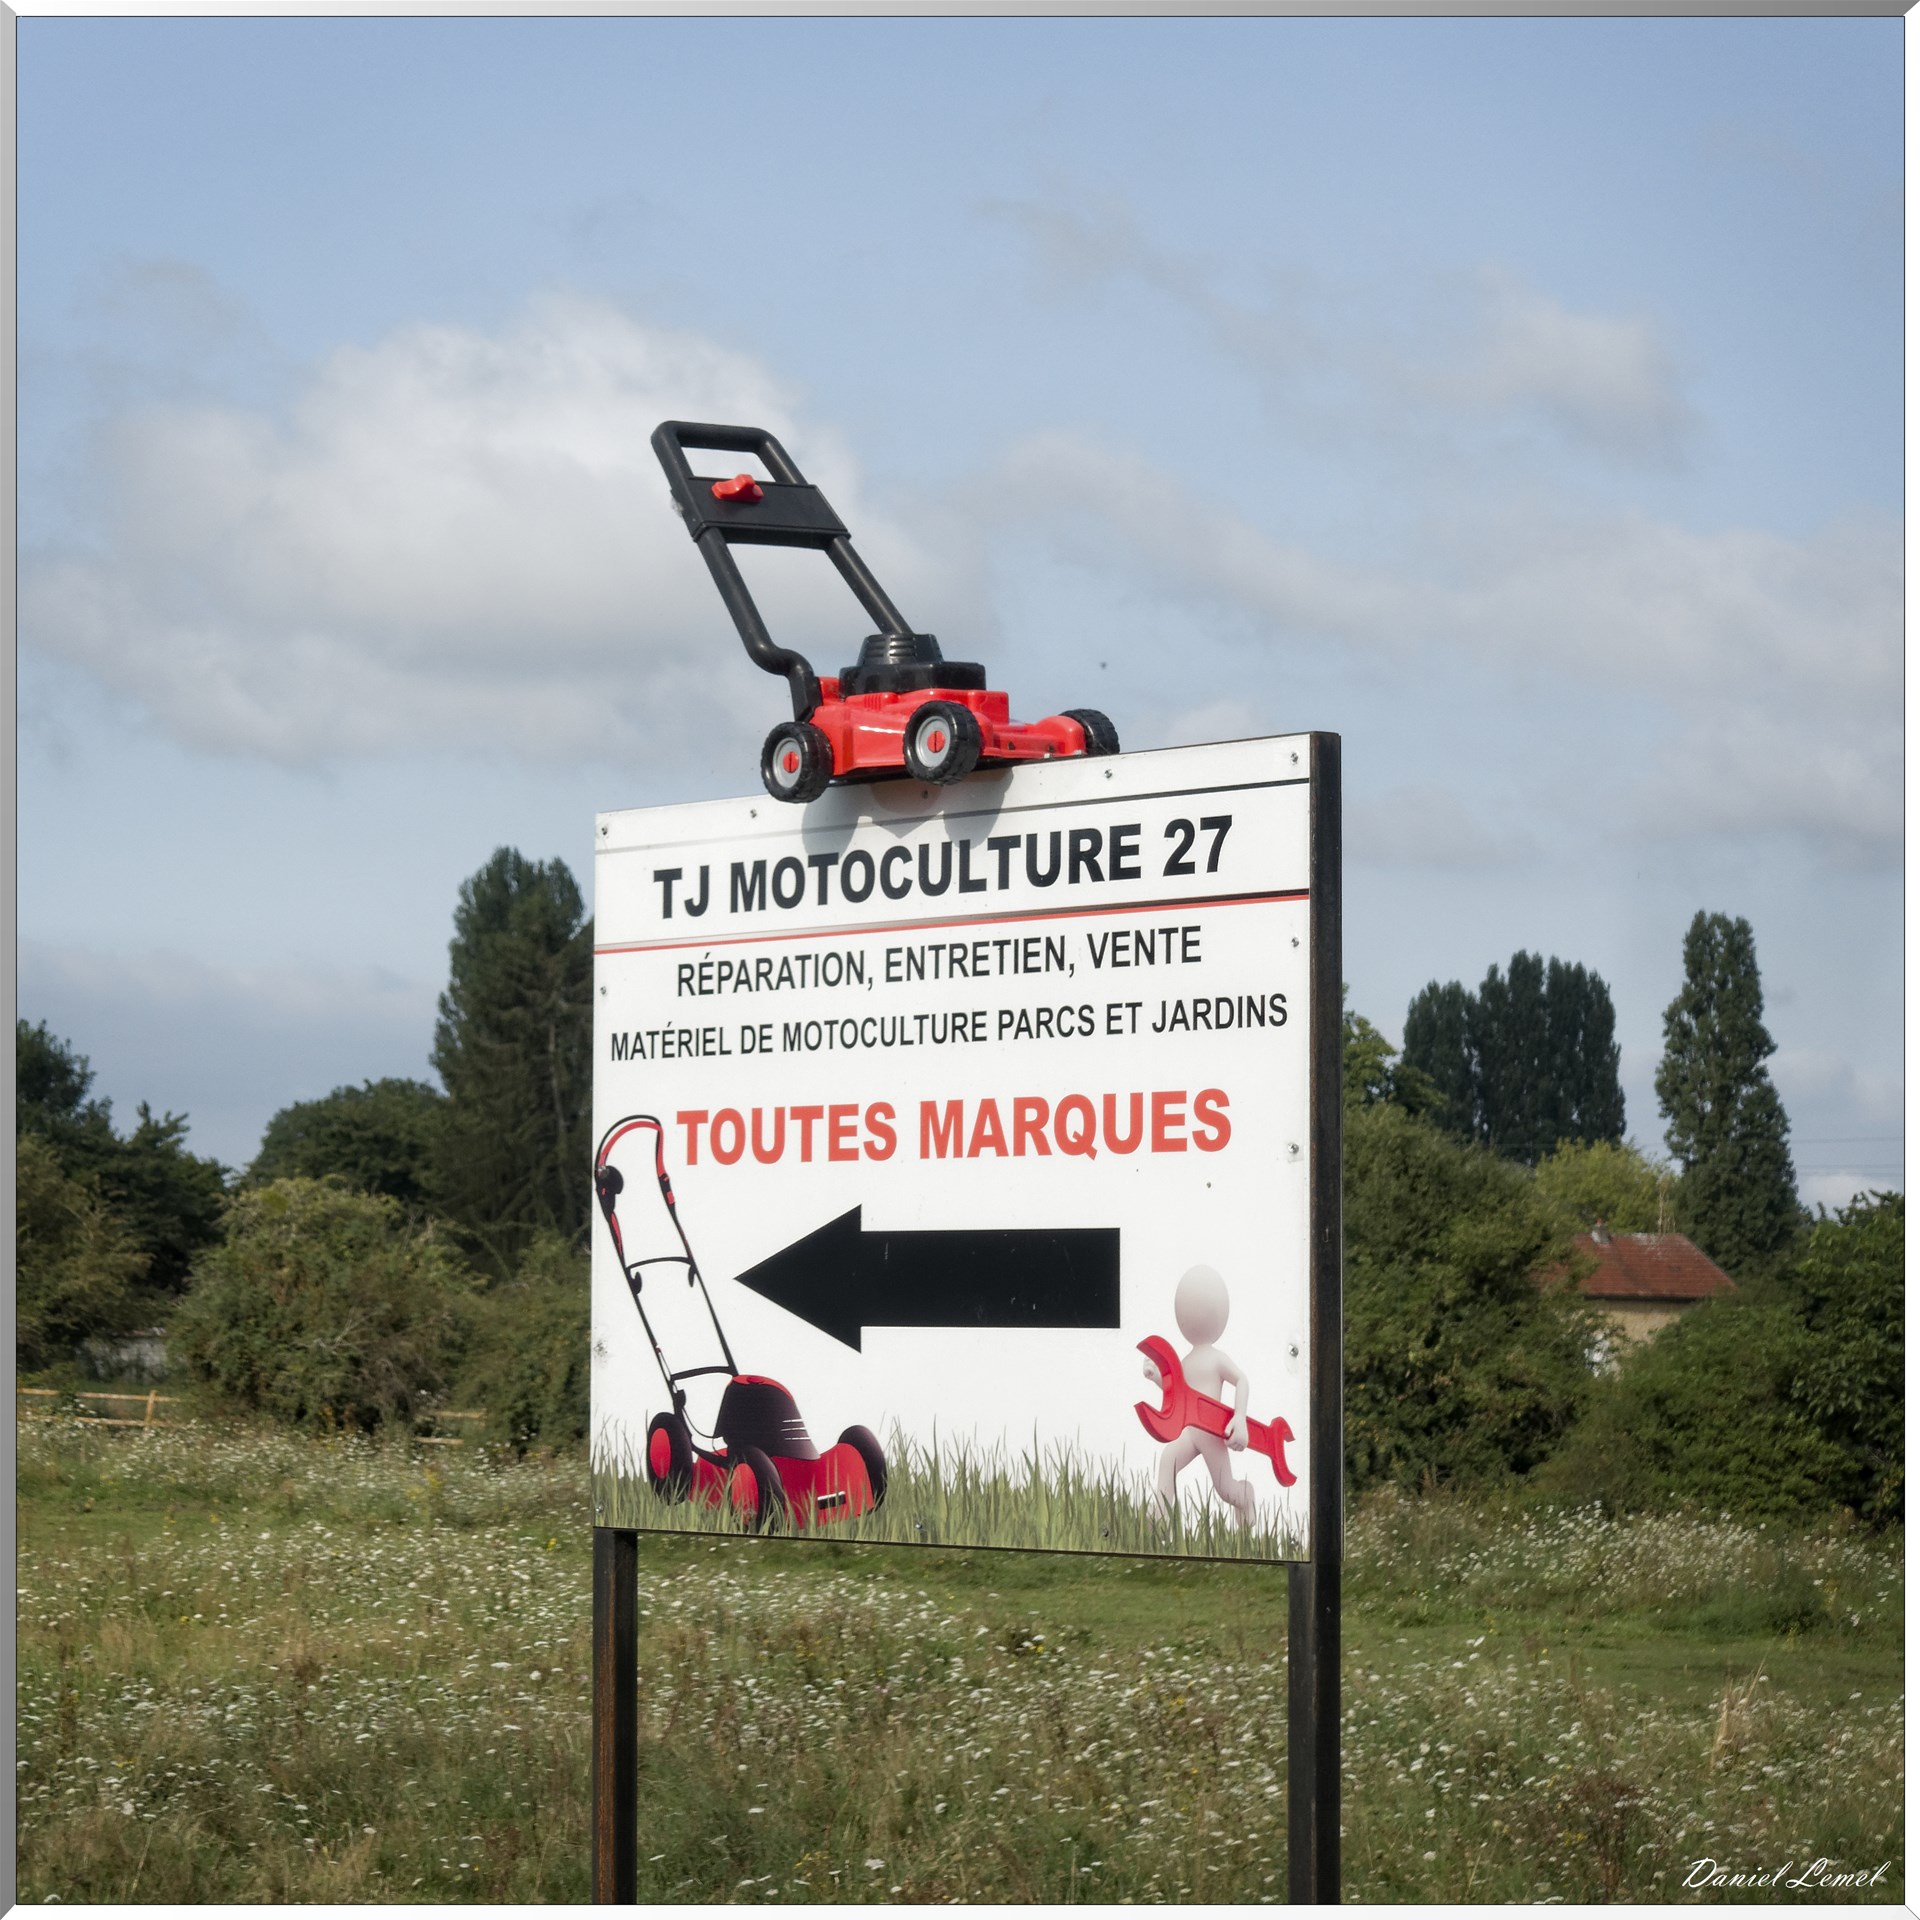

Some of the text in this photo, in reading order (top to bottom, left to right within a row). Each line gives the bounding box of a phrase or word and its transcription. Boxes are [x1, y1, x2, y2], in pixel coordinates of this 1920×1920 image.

[653, 814, 1233, 919] TJ MOTOCULTURE 27
[676, 925, 1202, 997] RÉPARATION, ENTRETIEN, VENTE
[611, 993, 1288, 1061] MATÉRIEL DE MOTOCULTURE PARCS ET JARDINS
[677, 1088, 1231, 1165] TOUTES MARQUES
